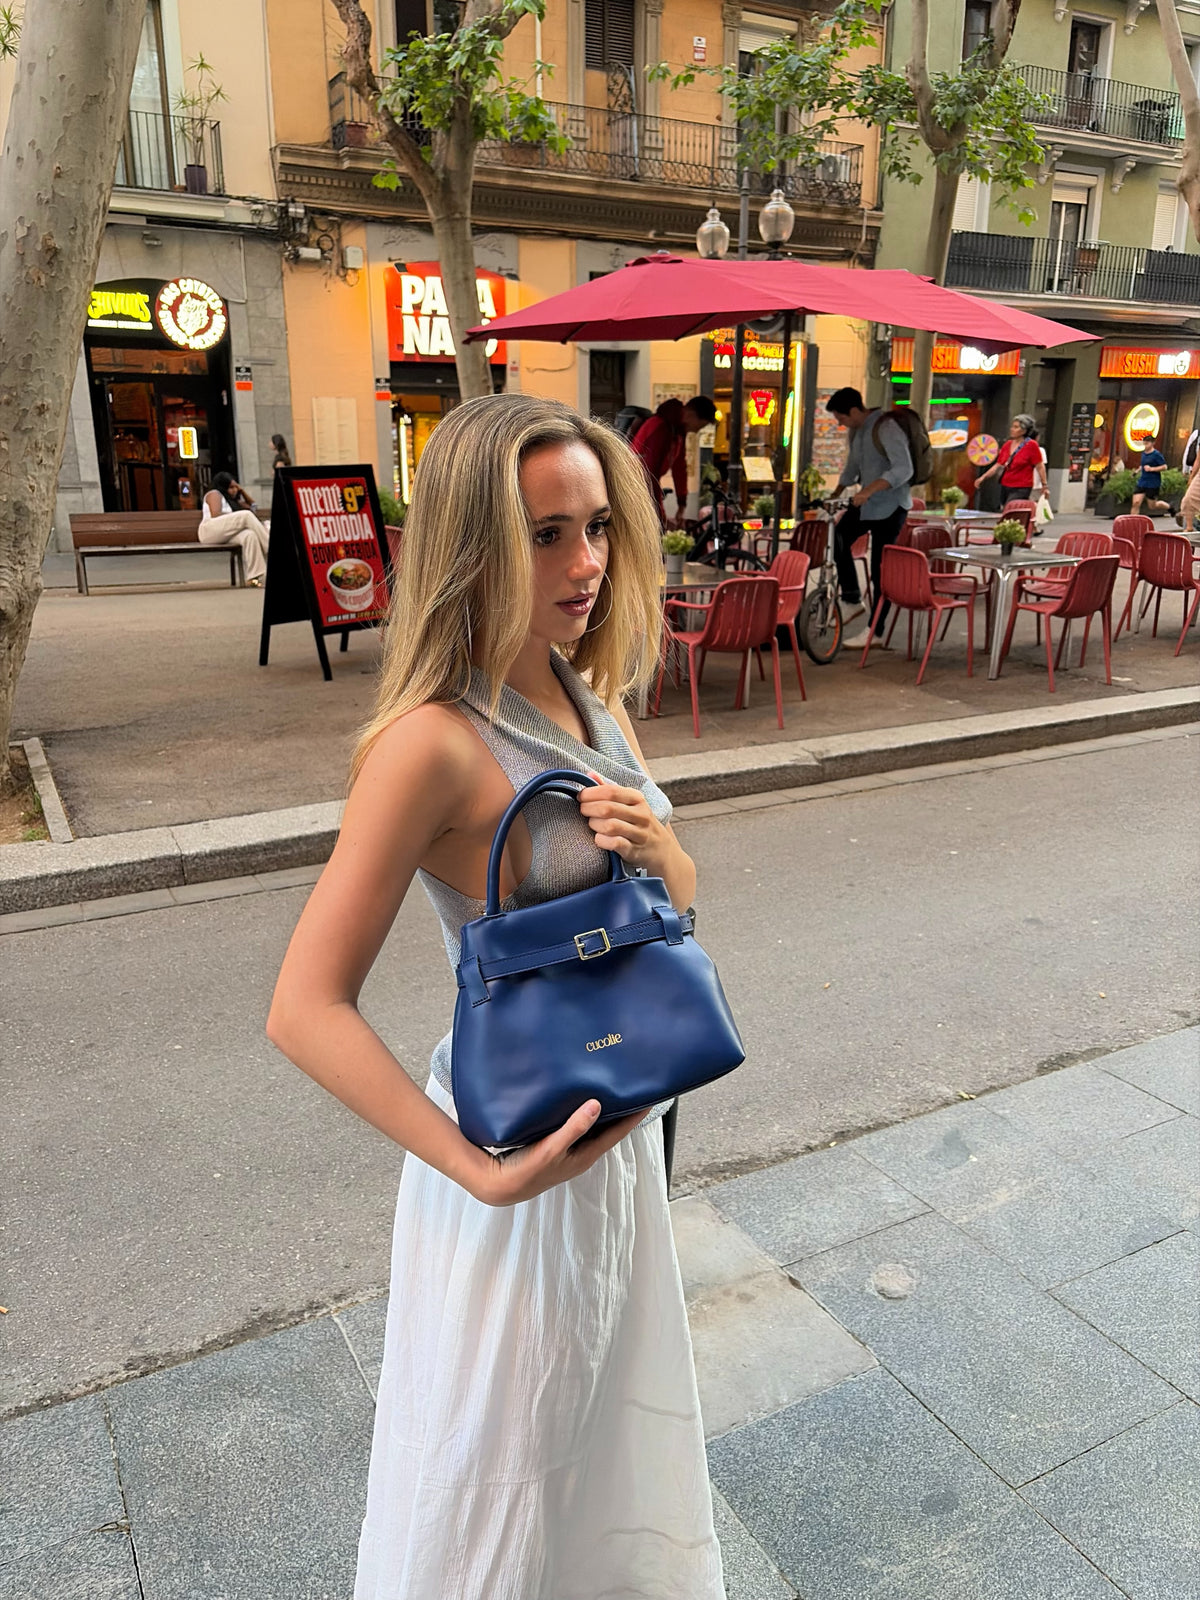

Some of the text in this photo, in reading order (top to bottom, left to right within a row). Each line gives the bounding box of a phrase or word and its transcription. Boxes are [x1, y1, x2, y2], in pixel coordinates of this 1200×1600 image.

[179, 278, 223, 311] COYOTES
[401, 275, 496, 317] PAA
[714, 354, 731, 368] LA
[1123, 353, 1157, 374] SUSHI
[298, 484, 345, 515] menú
[304, 513, 374, 545] MEDIODIA
[586, 1033, 623, 1052] cucolie
